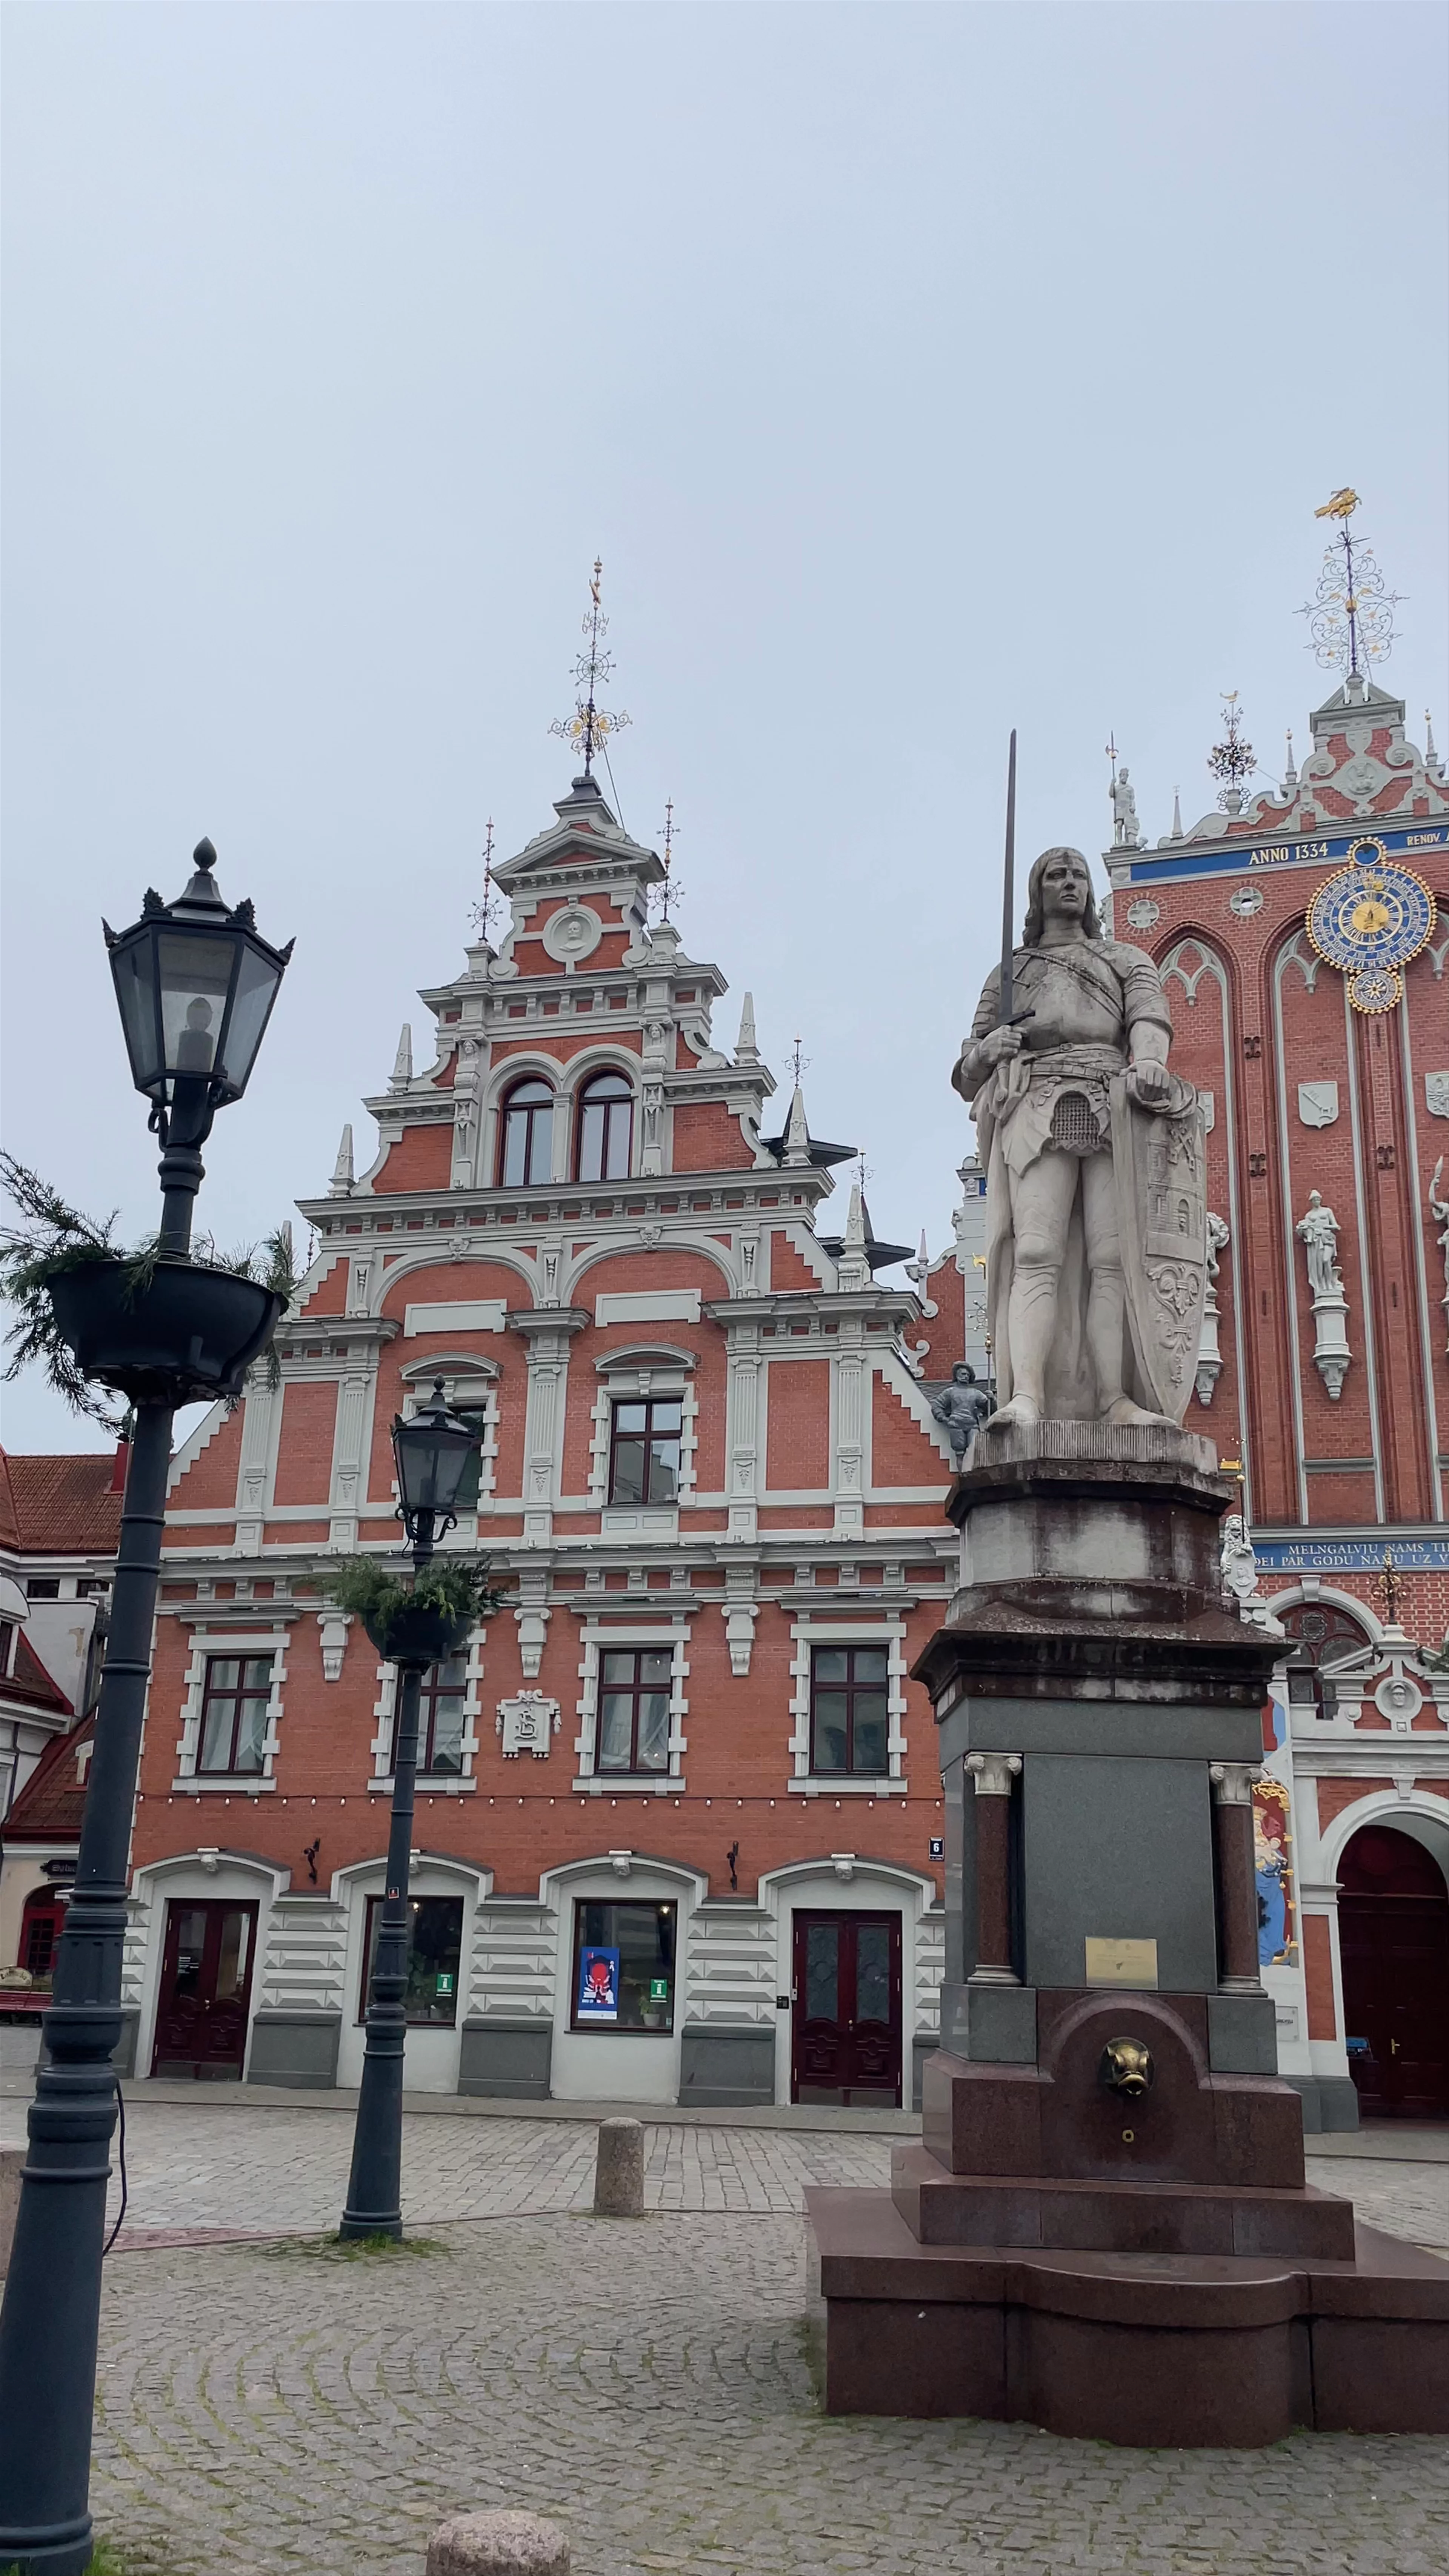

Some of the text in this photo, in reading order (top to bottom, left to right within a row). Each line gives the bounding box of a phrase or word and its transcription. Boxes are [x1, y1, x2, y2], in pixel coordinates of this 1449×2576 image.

[1249, 842, 1329, 866] ANNO 1334
[1289, 1542, 1449, 1555] MELNGALVJU NAMS TI
[1282, 1556, 1306, 1566] PAR
[1313, 1555, 1353, 1566] GODU
[1412, 1554, 1432, 1564] UZ
[934, 1843, 940, 1852] 6
